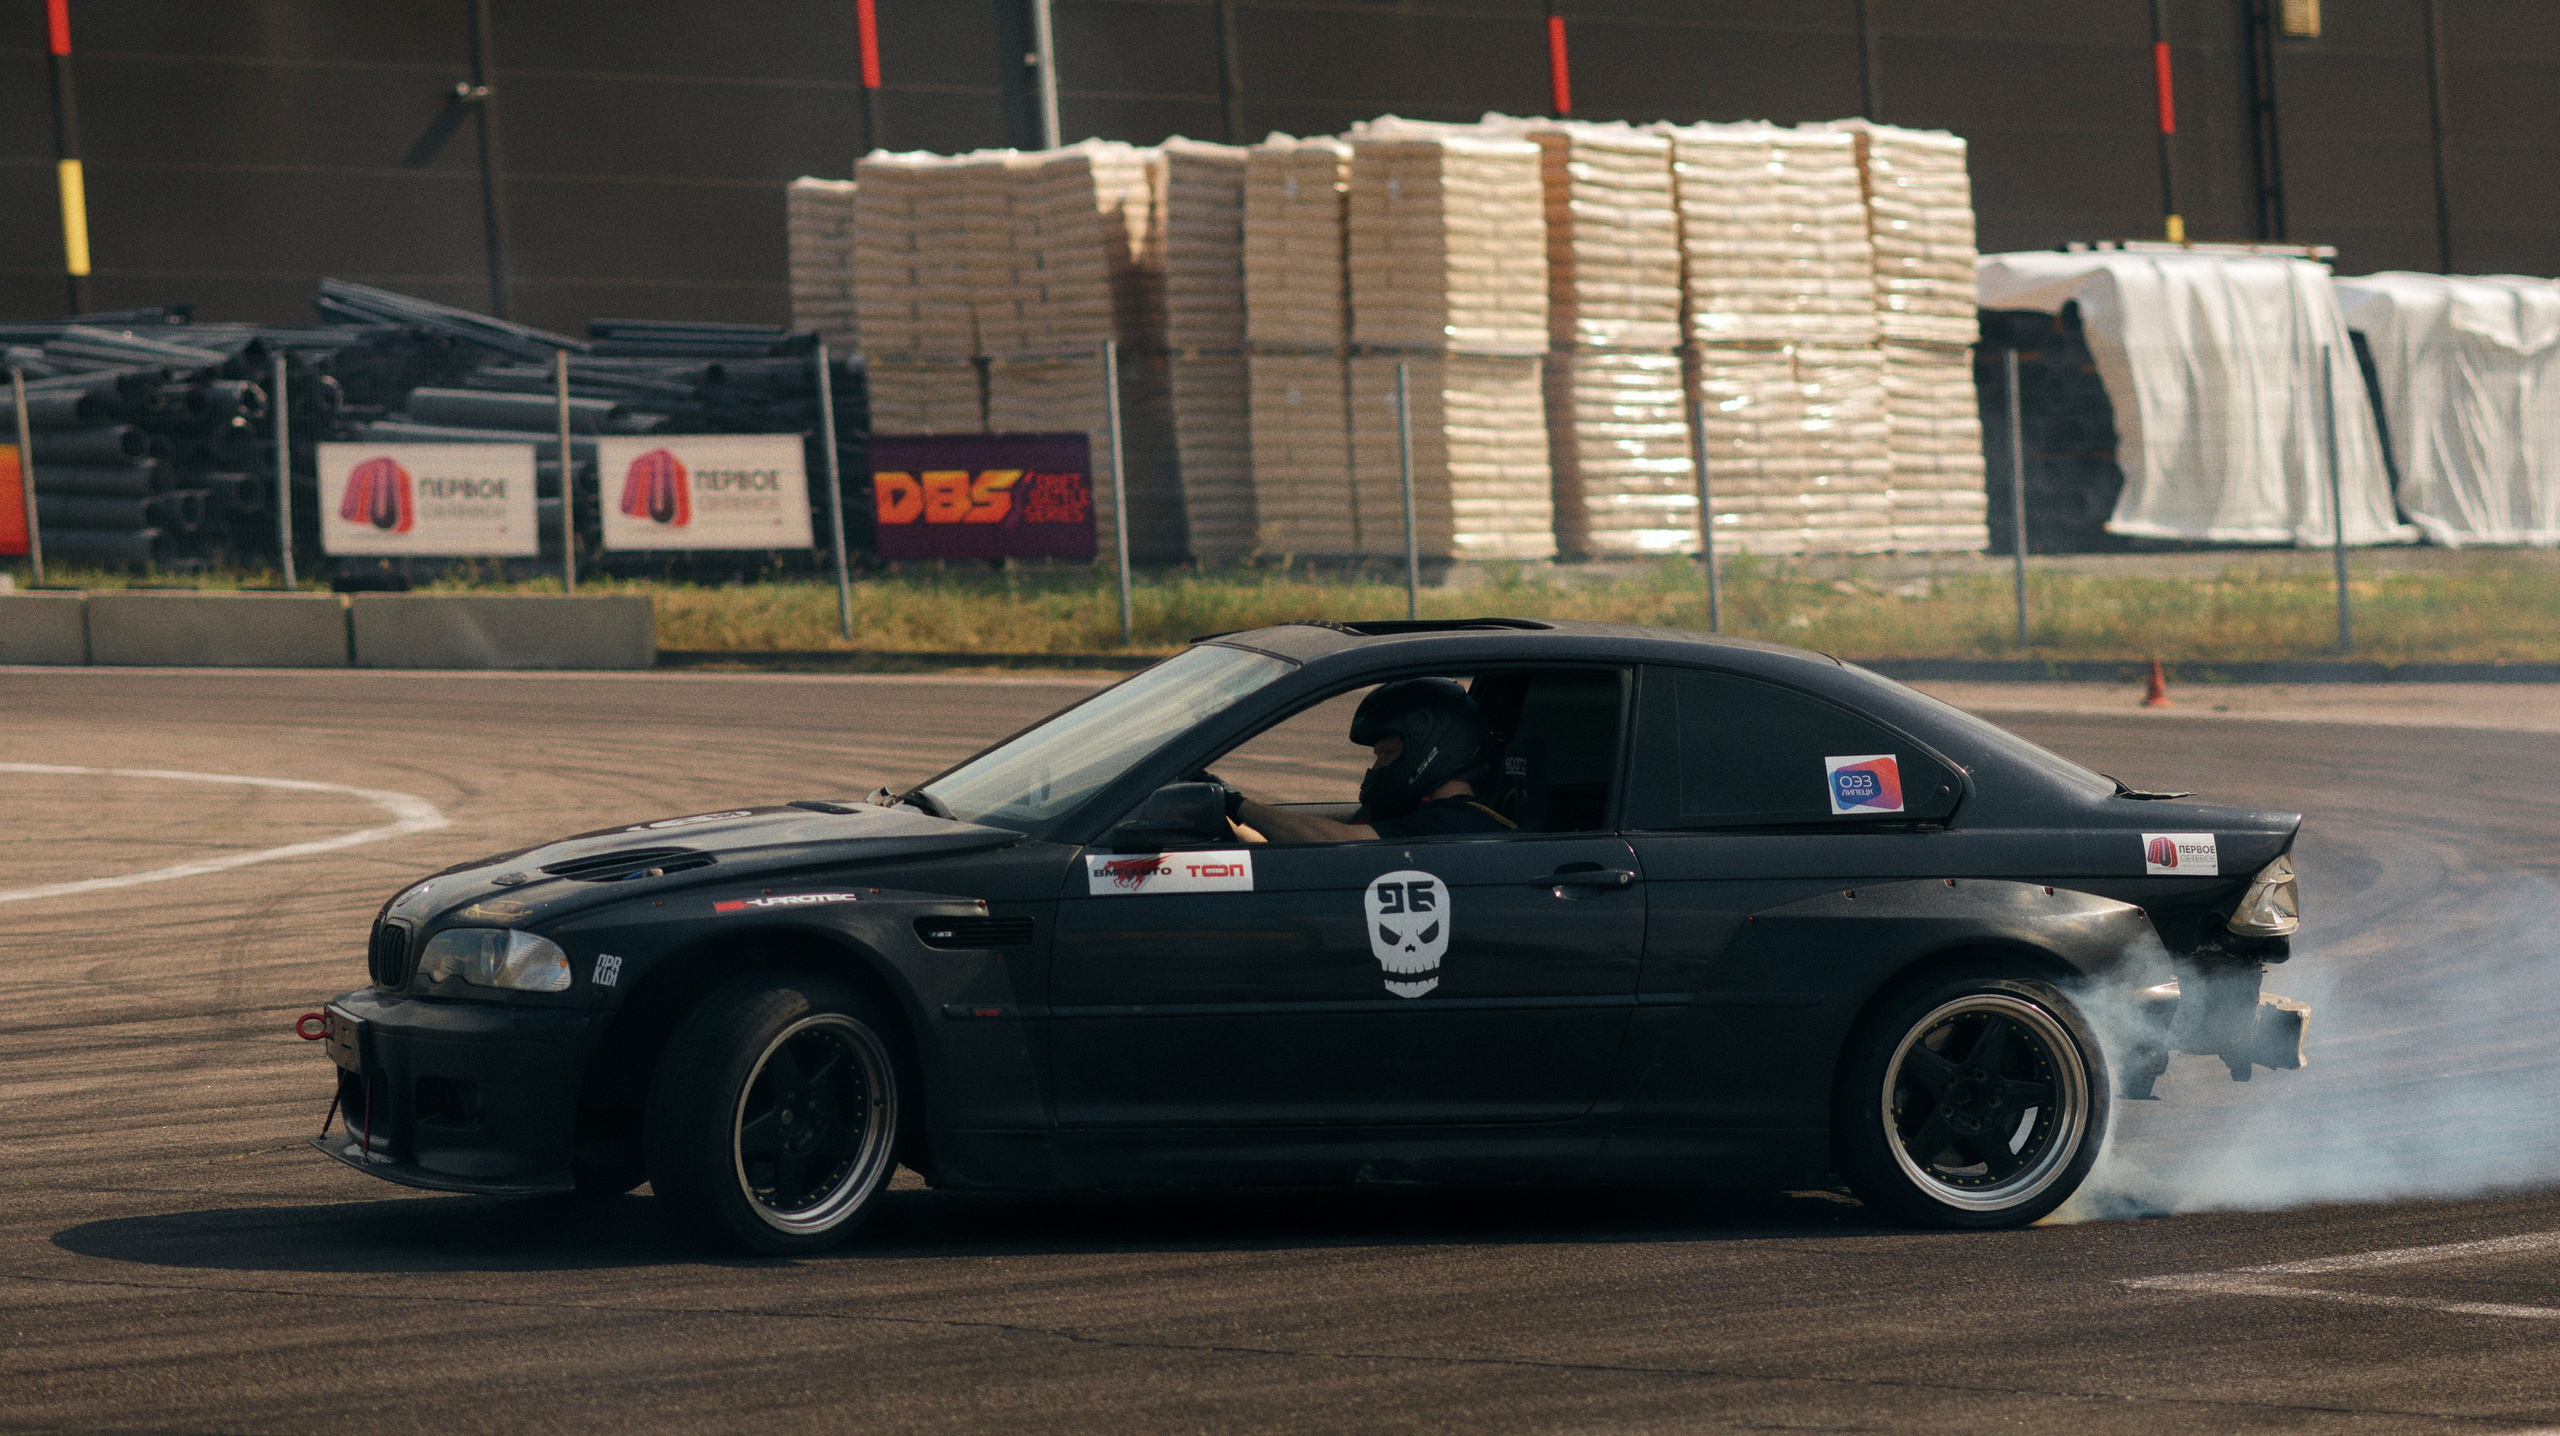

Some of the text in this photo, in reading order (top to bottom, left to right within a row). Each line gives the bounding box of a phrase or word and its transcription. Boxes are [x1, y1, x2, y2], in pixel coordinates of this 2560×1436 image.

[420, 478, 508, 499] ПЕРВОЕ
[695, 470, 780, 491] ПЕРВОЕ
[874, 470, 1023, 524] DBS
[1841, 788, 1874, 797] ЛИПЕЦК
[2179, 845, 2215, 853] ПЕРВОЕ
[1378, 881, 1436, 914] 96
